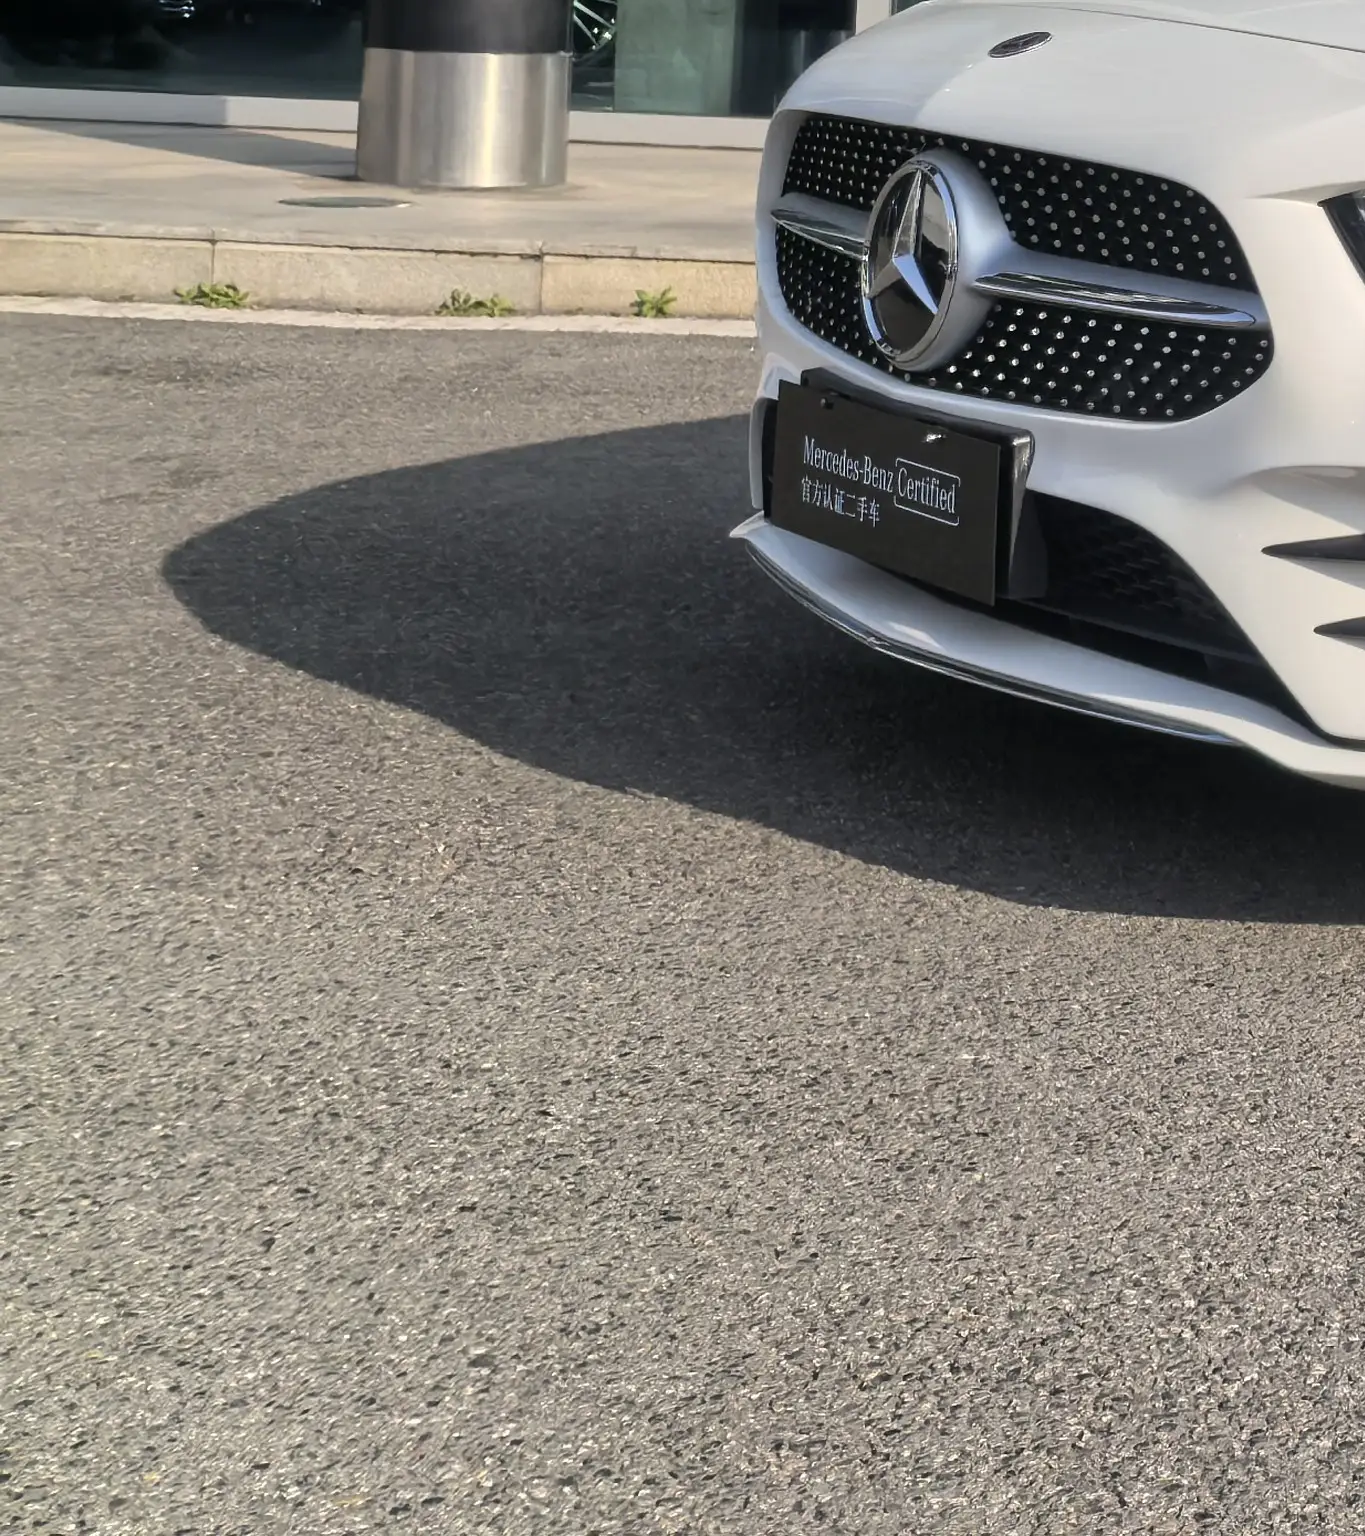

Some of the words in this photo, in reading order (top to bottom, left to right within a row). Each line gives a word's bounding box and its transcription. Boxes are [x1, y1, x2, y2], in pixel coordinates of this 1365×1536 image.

[800, 476, 880, 528] 官方认证二手车
[803, 435, 894, 493] Mercedes-Benz
[897, 467, 956, 514] Certified
